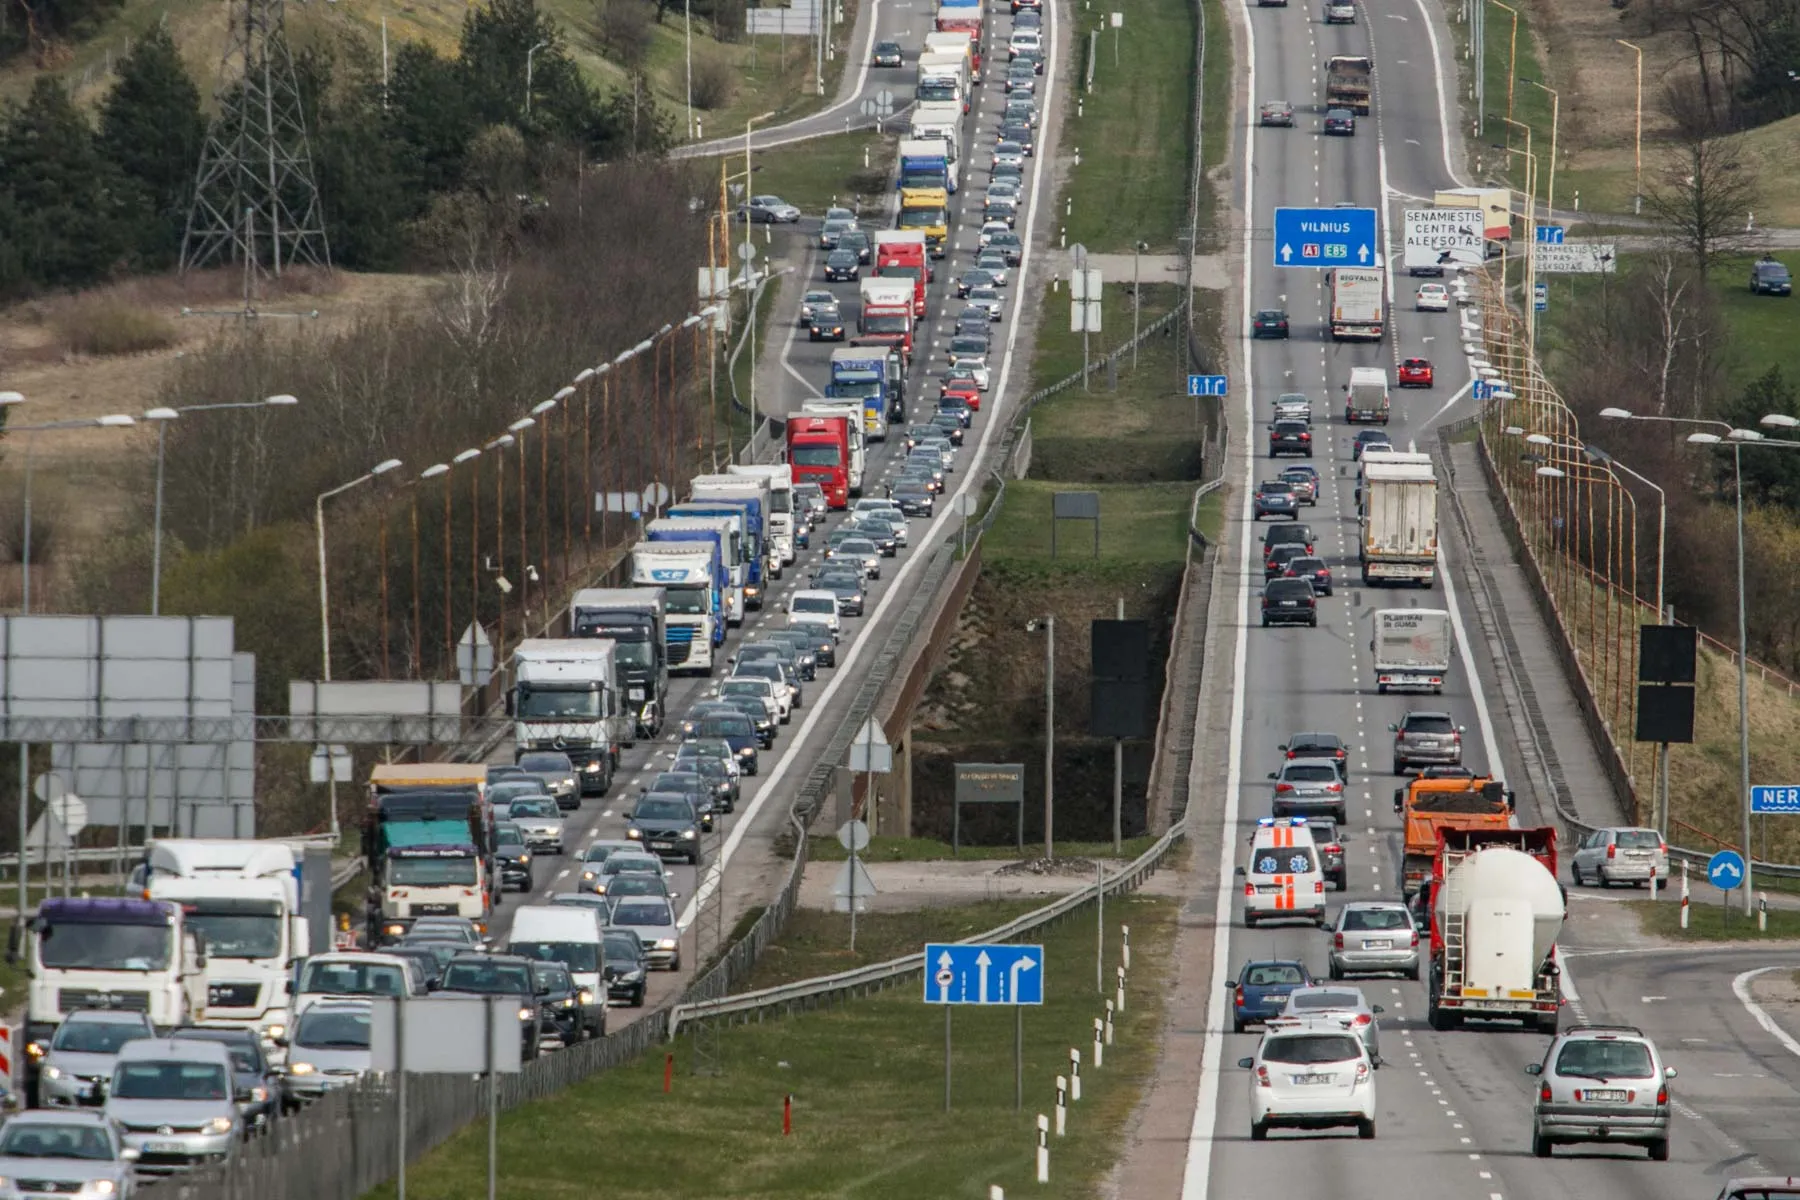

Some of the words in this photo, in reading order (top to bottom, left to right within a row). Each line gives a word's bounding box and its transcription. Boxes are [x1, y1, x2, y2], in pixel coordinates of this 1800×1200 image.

[1407, 212, 1482, 222] SENAMIESTIS
[1300, 222, 1351, 233] VILNIUS
[1407, 236, 1482, 246] ALEKSOTAS
[1304, 245, 1318, 256] A1
[1325, 245, 1347, 256] E85
[1763, 789, 1800, 804] NER
